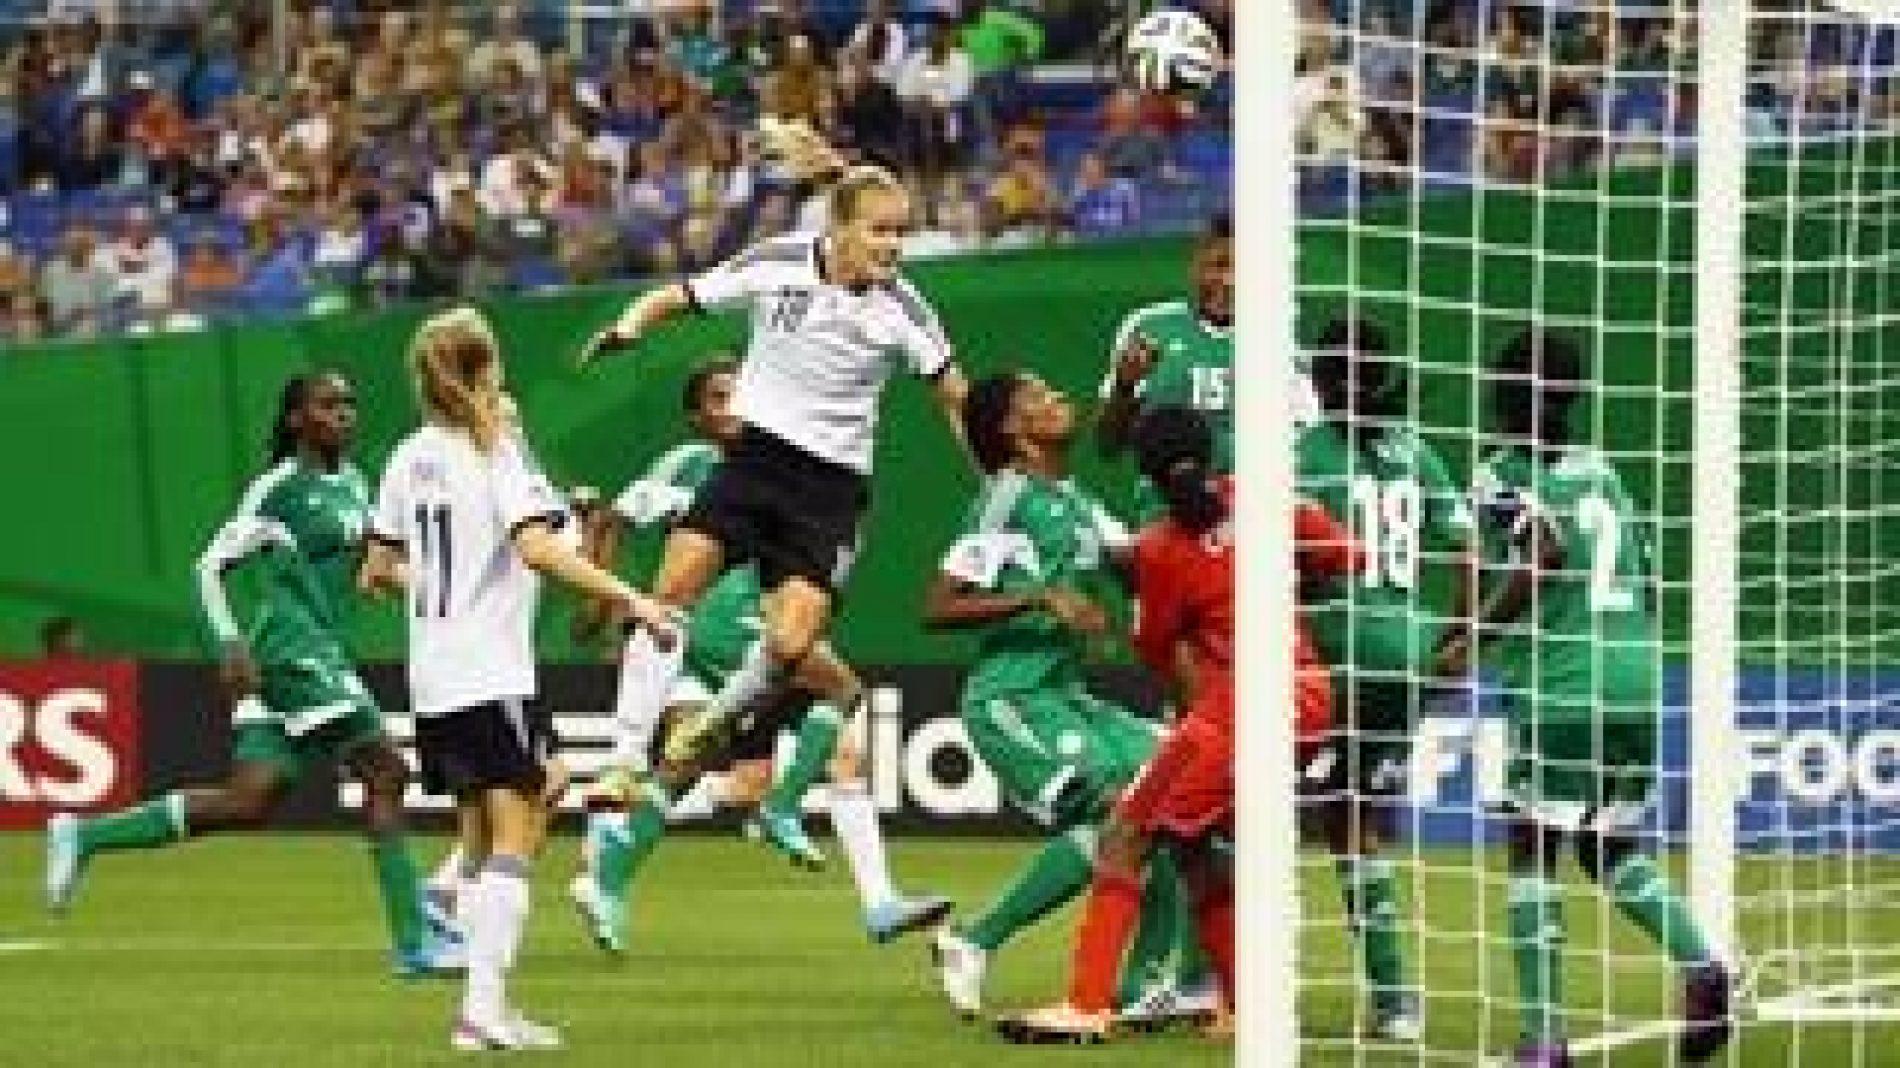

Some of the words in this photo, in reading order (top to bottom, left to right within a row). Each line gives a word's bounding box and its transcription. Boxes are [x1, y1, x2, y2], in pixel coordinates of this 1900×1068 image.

[1187, 366, 1230, 410] 15
[415, 503, 453, 618] 11
[1352, 474, 1420, 588] 18
[1576, 493, 1635, 611] 2
